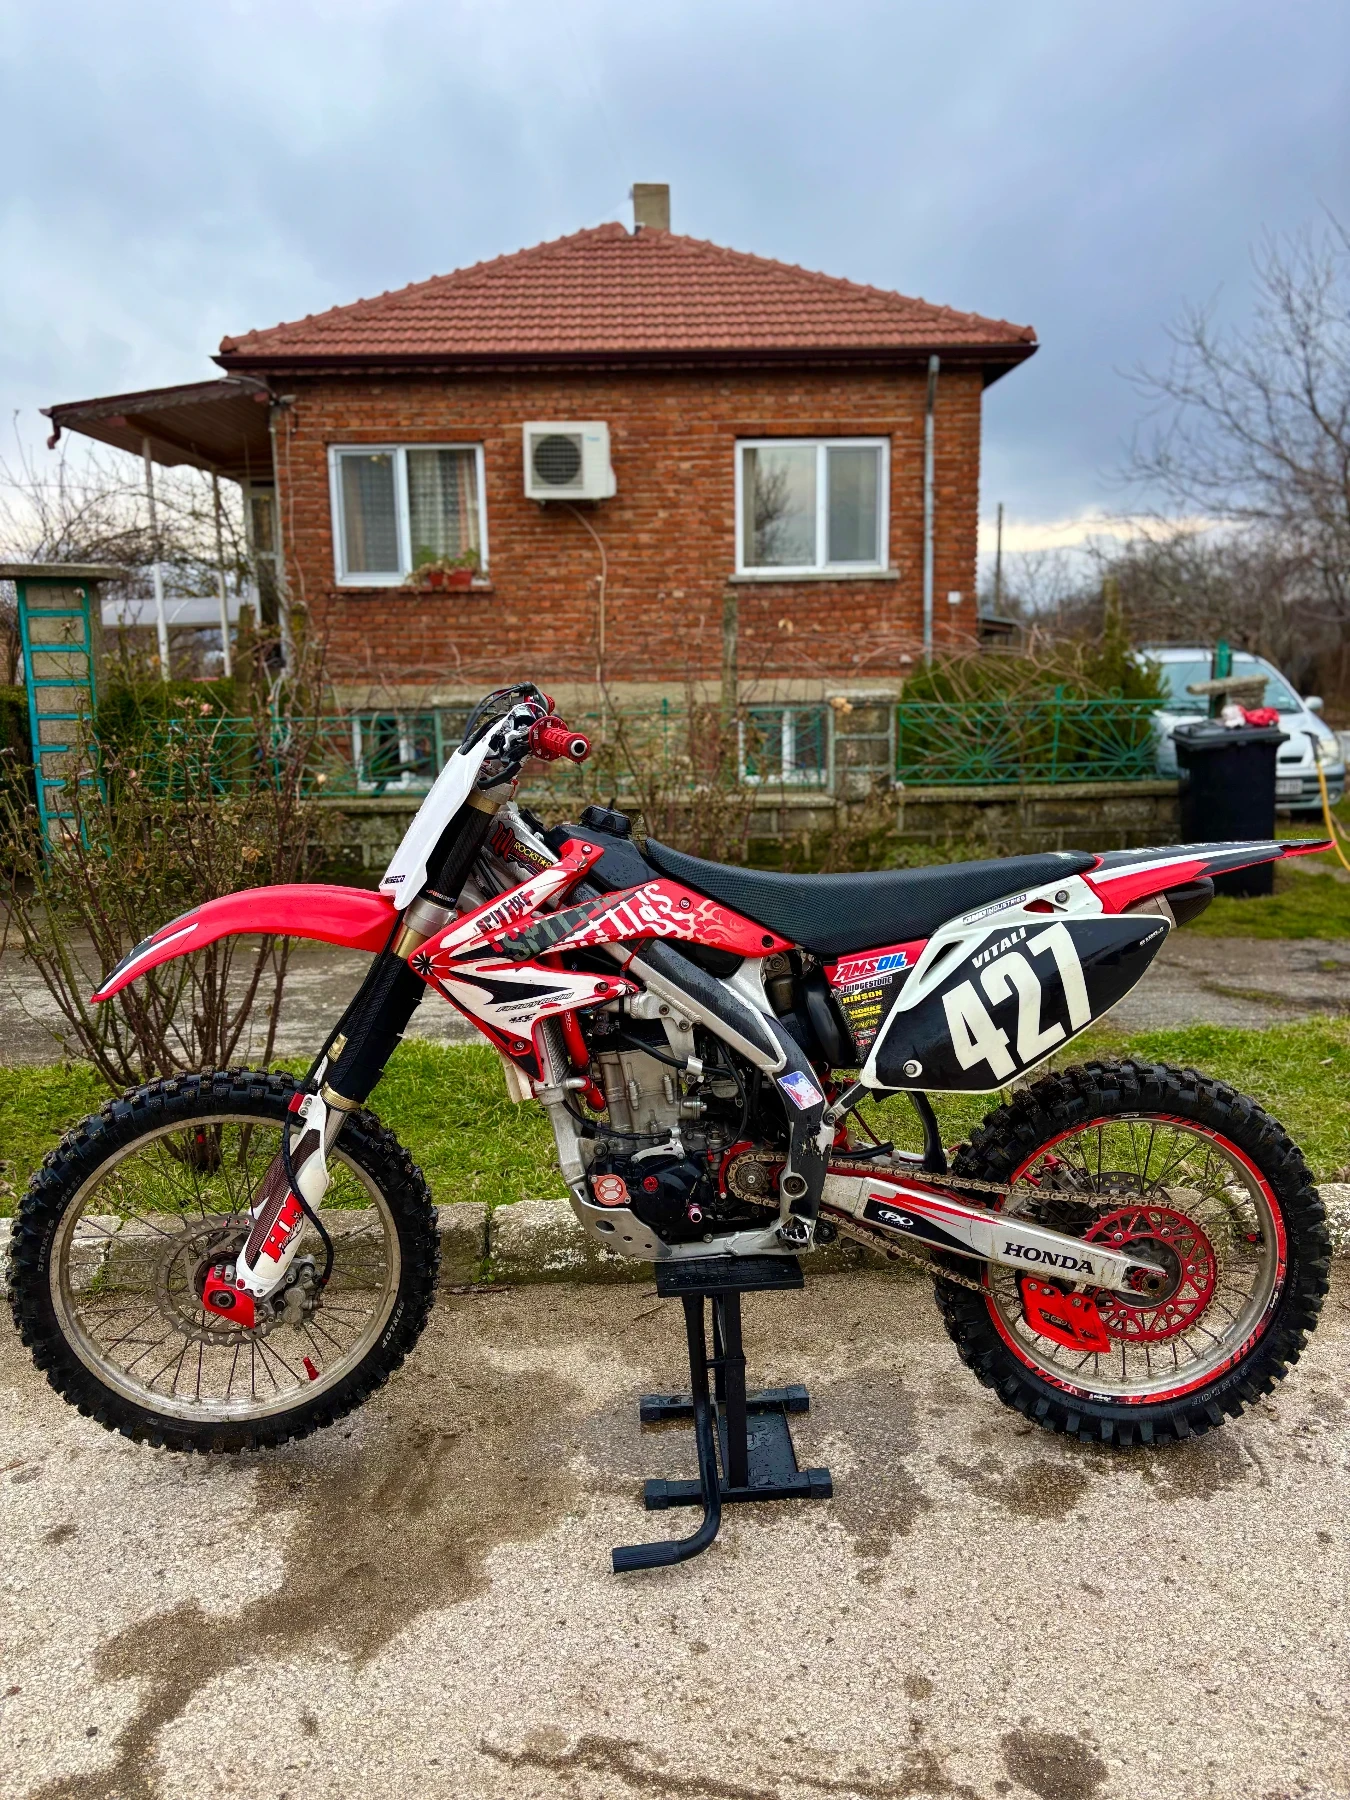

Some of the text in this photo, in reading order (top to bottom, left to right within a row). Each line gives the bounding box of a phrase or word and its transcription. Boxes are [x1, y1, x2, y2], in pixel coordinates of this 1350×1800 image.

[972, 927, 1026, 969] VITALI
[832, 951, 908, 983] AMSOIL
[842, 990, 883, 1004] HINSON
[942, 921, 1092, 1081] 427
[1003, 1241, 1095, 1275] HONDA
